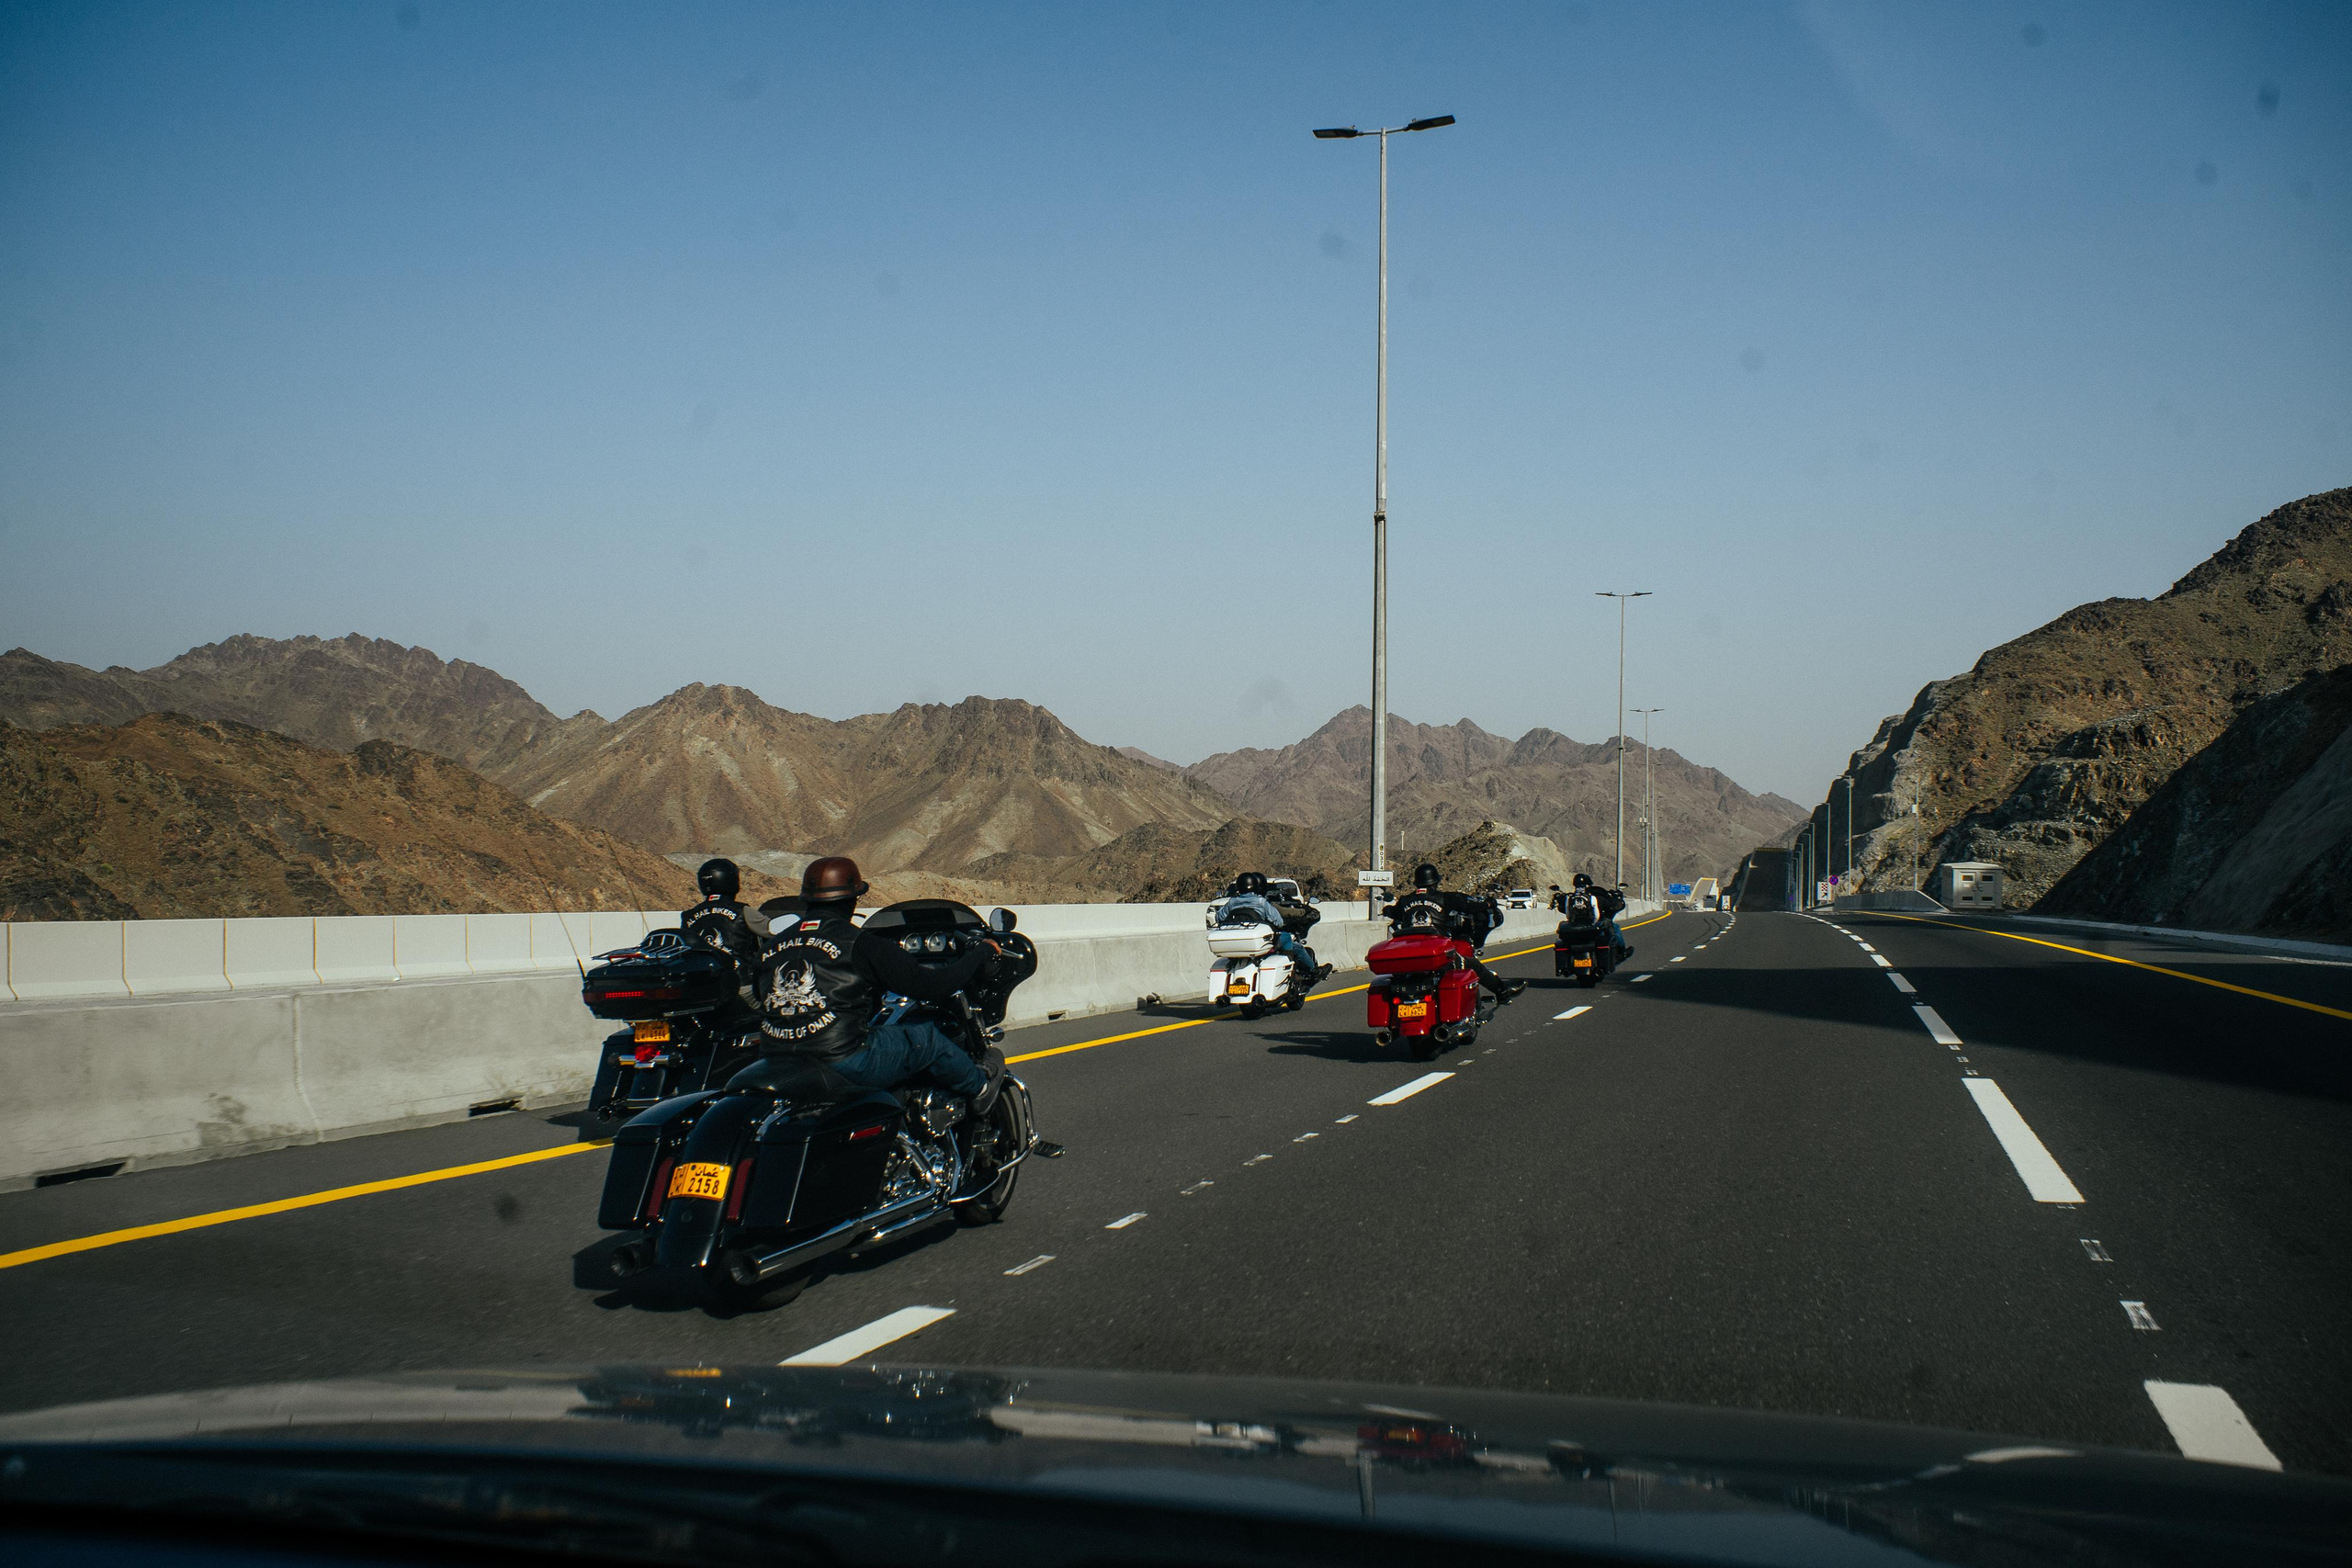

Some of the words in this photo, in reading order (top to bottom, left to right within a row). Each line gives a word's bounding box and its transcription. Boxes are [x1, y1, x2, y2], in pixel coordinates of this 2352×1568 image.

[686, 919, 695, 929] AL
[694, 908, 711, 920] HAIL
[711, 907, 737, 920] BIKERS
[762, 949, 777, 963] AL
[777, 937, 804, 952] HAIL
[806, 937, 842, 960] BIKERS
[796, 1025, 808, 1039] OF
[808, 1011, 837, 1034] OMAN
[687, 1178, 719, 1195] 2158
